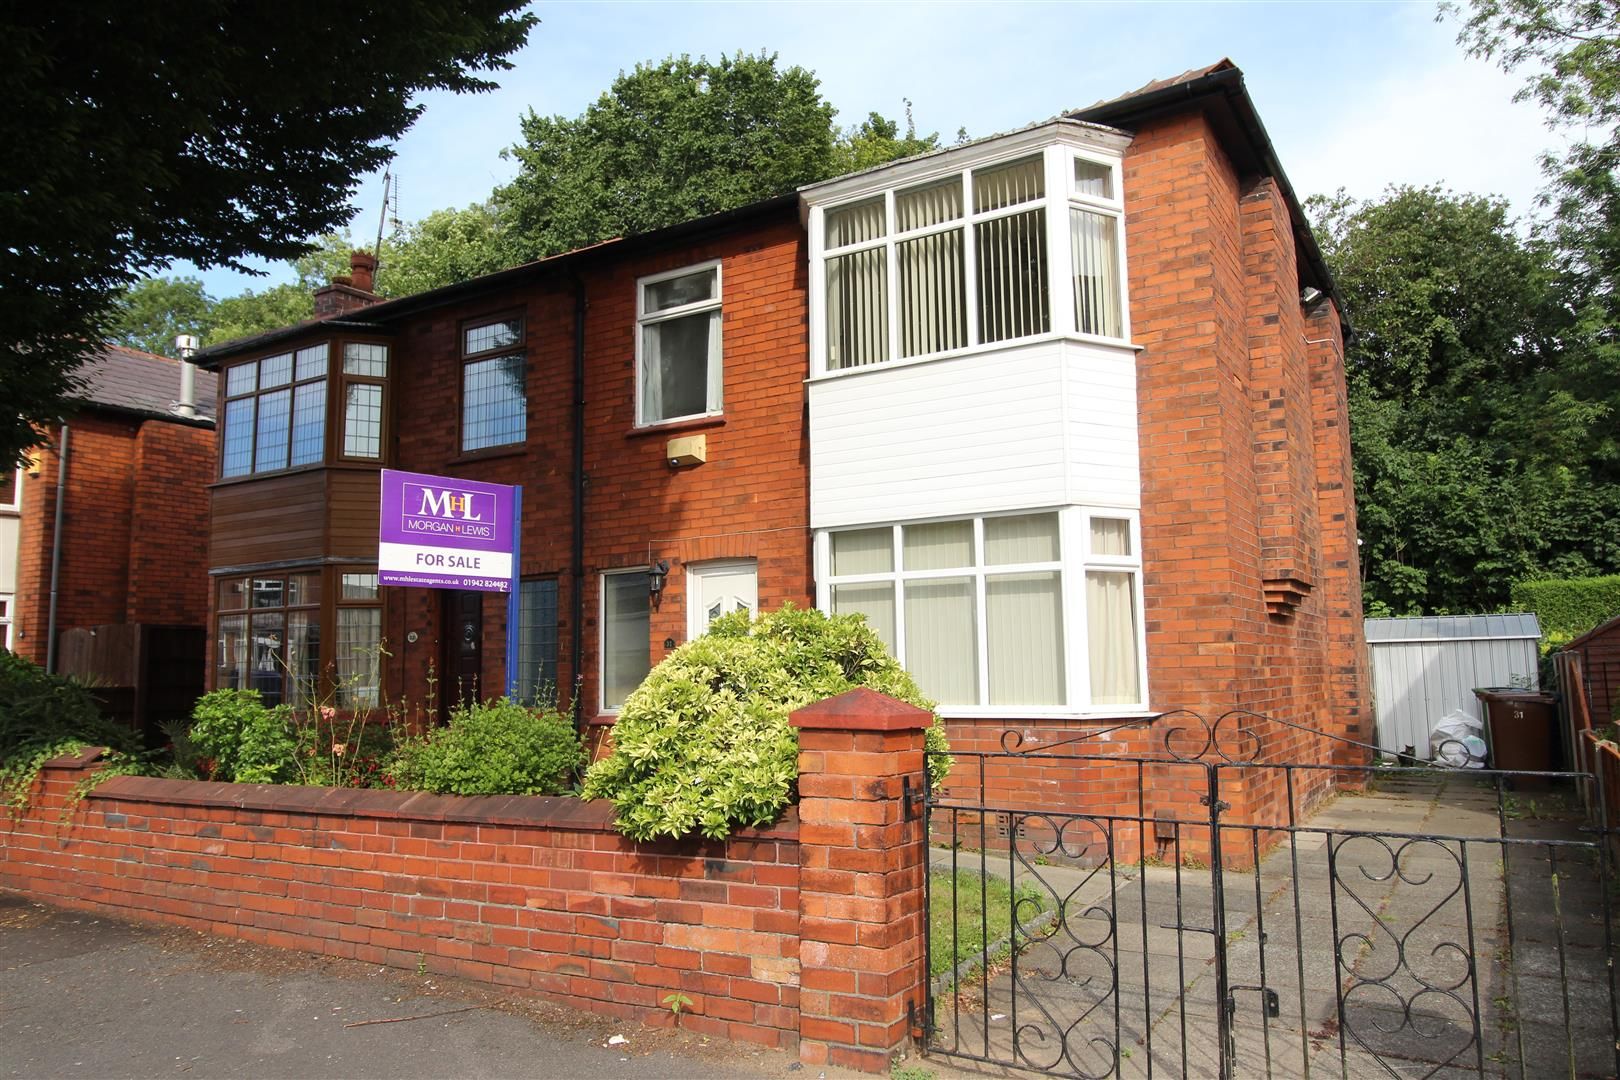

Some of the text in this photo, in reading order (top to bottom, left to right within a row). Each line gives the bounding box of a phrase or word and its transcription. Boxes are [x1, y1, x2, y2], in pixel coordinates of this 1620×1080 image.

[408, 519, 454, 533] MORGAN
[462, 526, 490, 537] LEWIS
[416, 553, 481, 569] FOR SALE
[463, 578, 483, 586] 01942
